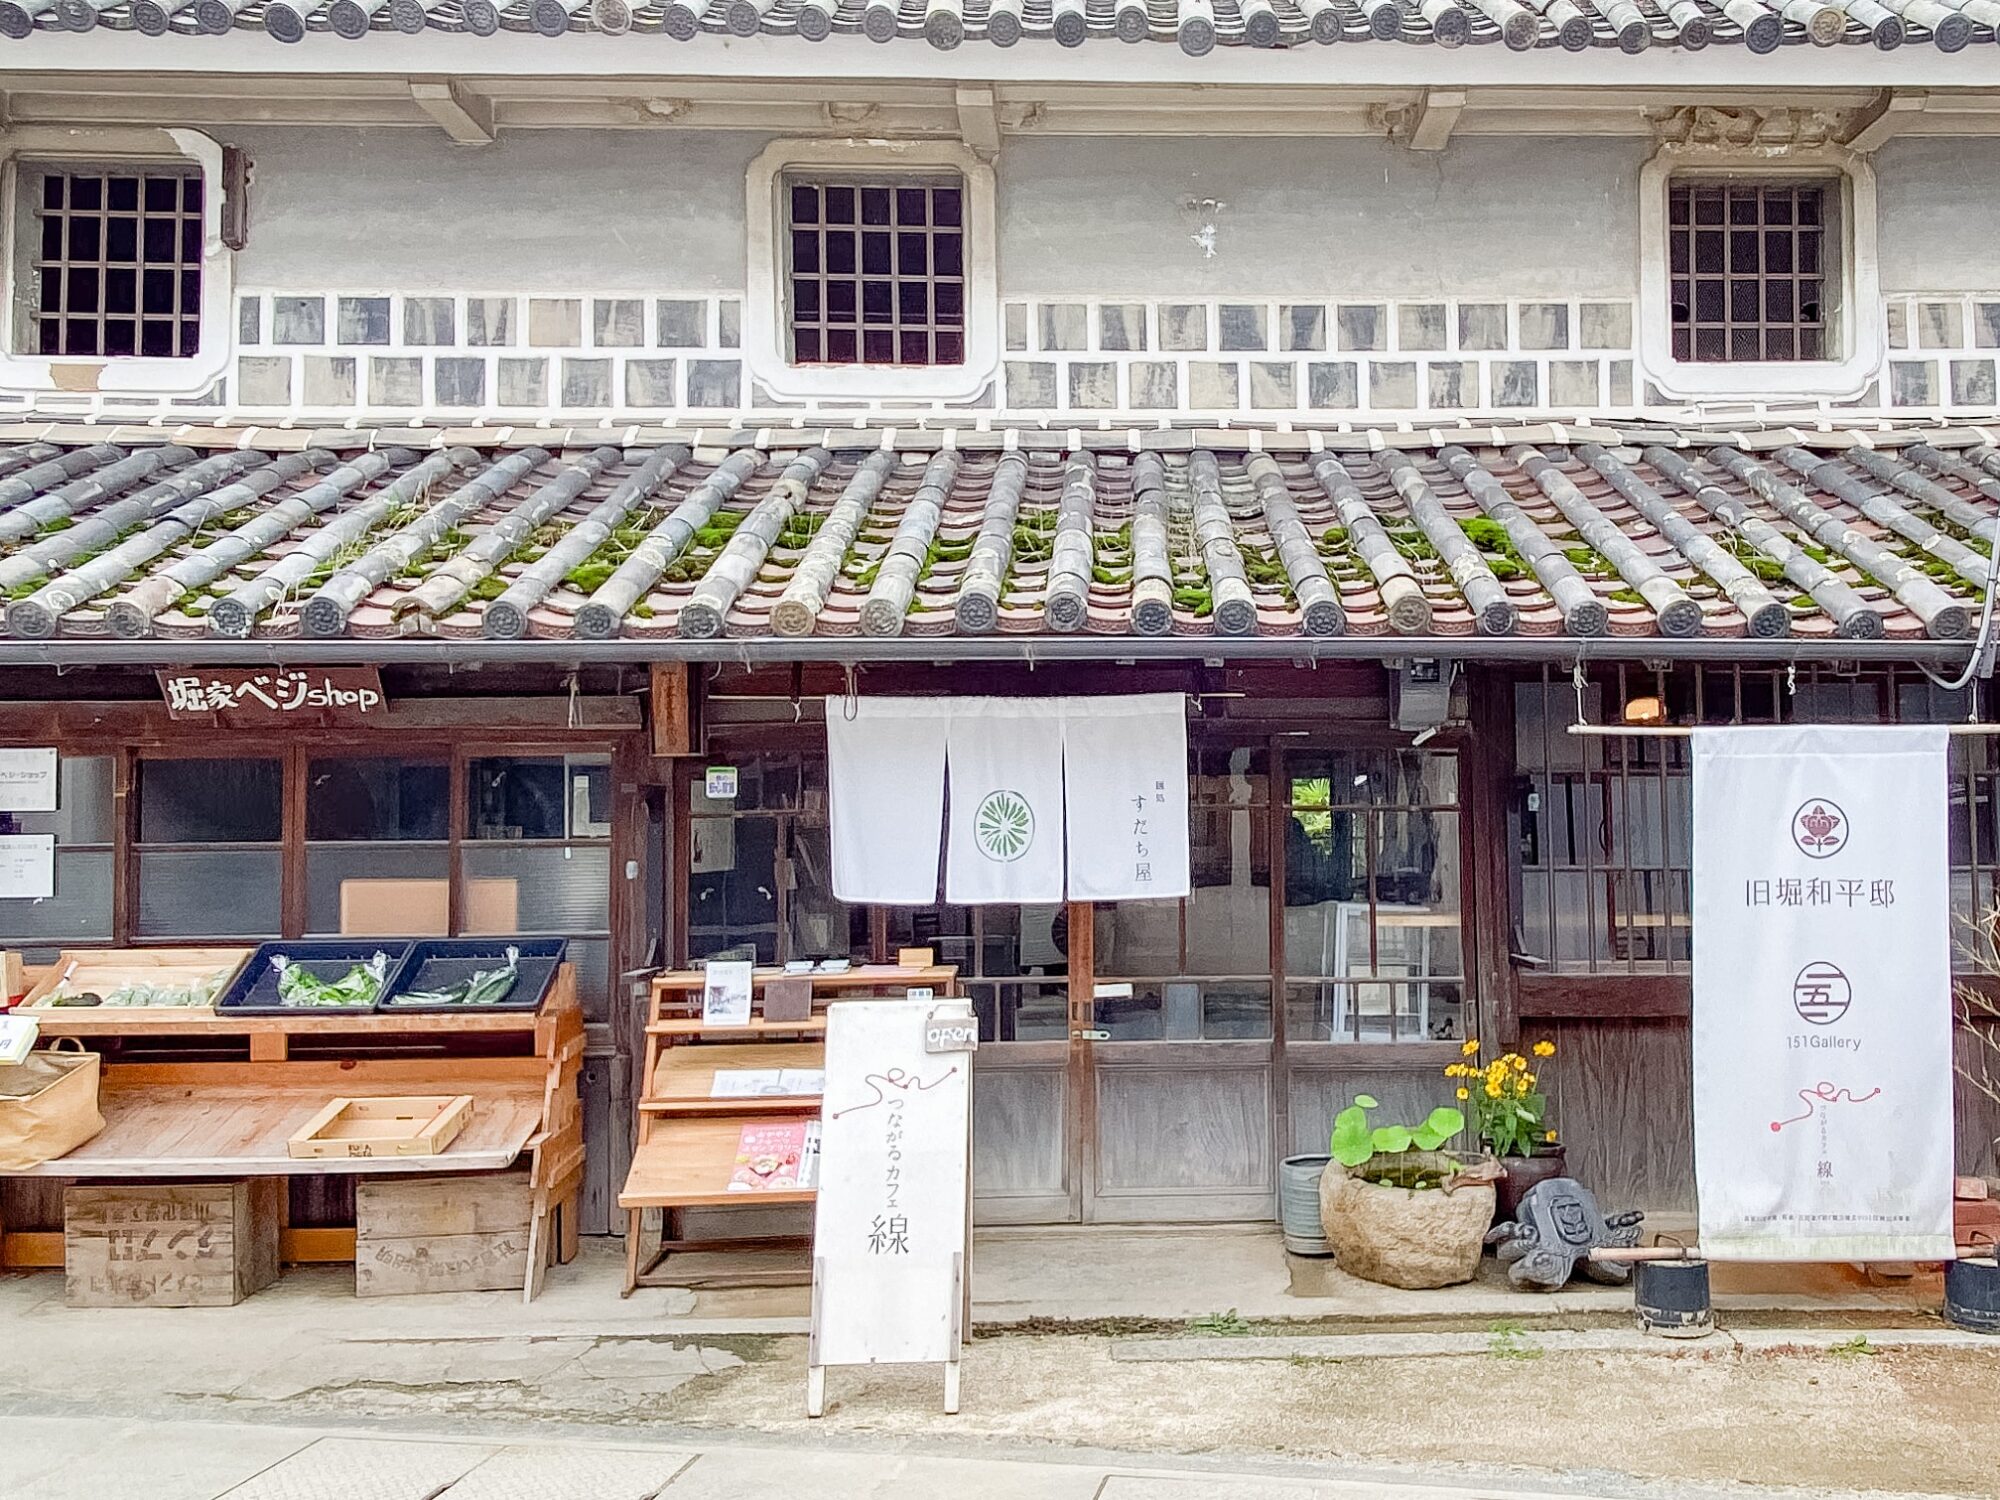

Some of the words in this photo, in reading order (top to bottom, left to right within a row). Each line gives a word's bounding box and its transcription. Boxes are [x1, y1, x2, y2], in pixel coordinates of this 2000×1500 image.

[1131, 794, 1153, 882] すだち屋
[1746, 877, 1896, 908] 旧堀和平邸
[886, 1098, 905, 1209] つながるカフェ
[867, 1213, 910, 1256] 線
